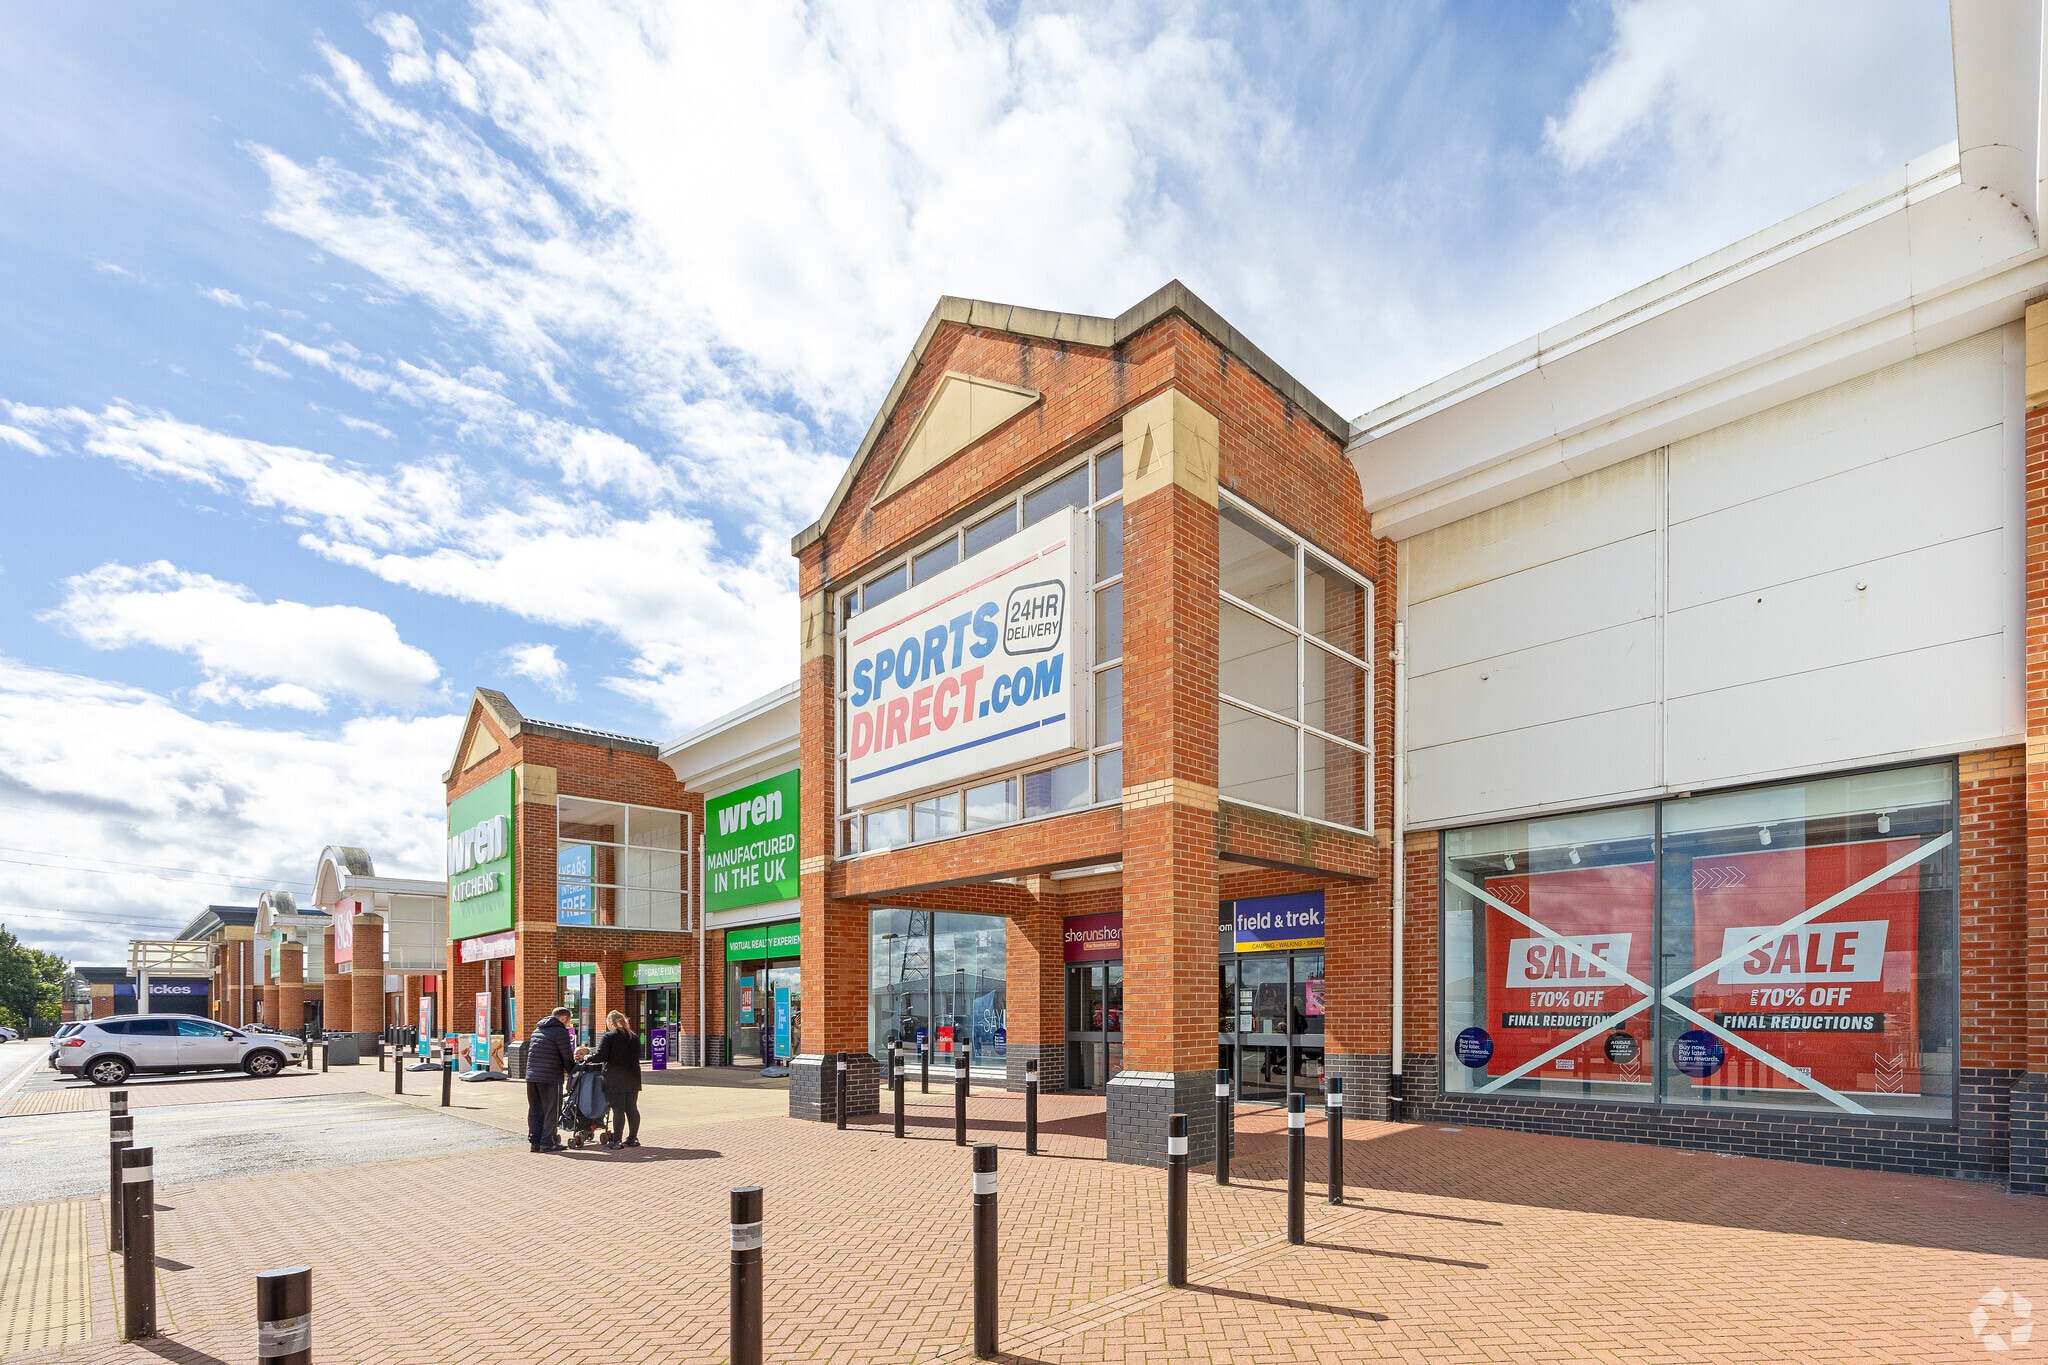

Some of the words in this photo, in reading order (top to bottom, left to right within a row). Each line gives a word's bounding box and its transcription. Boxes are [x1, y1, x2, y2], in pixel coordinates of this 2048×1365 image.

[1010, 594, 1059, 623] 24HR
[1006, 621, 1060, 641] DELIVERY
[851, 602, 1000, 707] SPORTS
[850, 653, 1065, 762] DIRECT.COM
[719, 790, 783, 836] wren
[448, 814, 508, 876] wren
[707, 833, 796, 871] MANUFACTURED
[452, 872, 499, 902] KITCHENS
[714, 871, 728, 893] IN
[731, 864, 760, 890] THE
[763, 857, 787, 883] UK
[561, 894, 587, 918] FREE
[1218, 923, 1233, 932] om
[1237, 911, 1271, 931] field
[1274, 914, 1284, 928] &
[1286, 908, 1325, 927] trek.
[729, 941, 752, 952] VIRTUAL
[1251, 941, 1275, 950] CAMPING
[1279, 940, 1303, 948] WALKING
[1744, 931, 1860, 976] SALE
[1524, 942, 1611, 981] SALE
[1537, 990, 1571, 1008] 70%
[1573, 990, 1605, 1007] OFF
[1760, 987, 1806, 1007] 70%
[1809, 987, 1853, 1006] OFF
[1508, 1014, 1541, 1027] FINAL
[1722, 1015, 1767, 1029] FINAL
[1770, 1016, 1875, 1031] REDUCTIONS
[652, 1037, 667, 1047] 60
